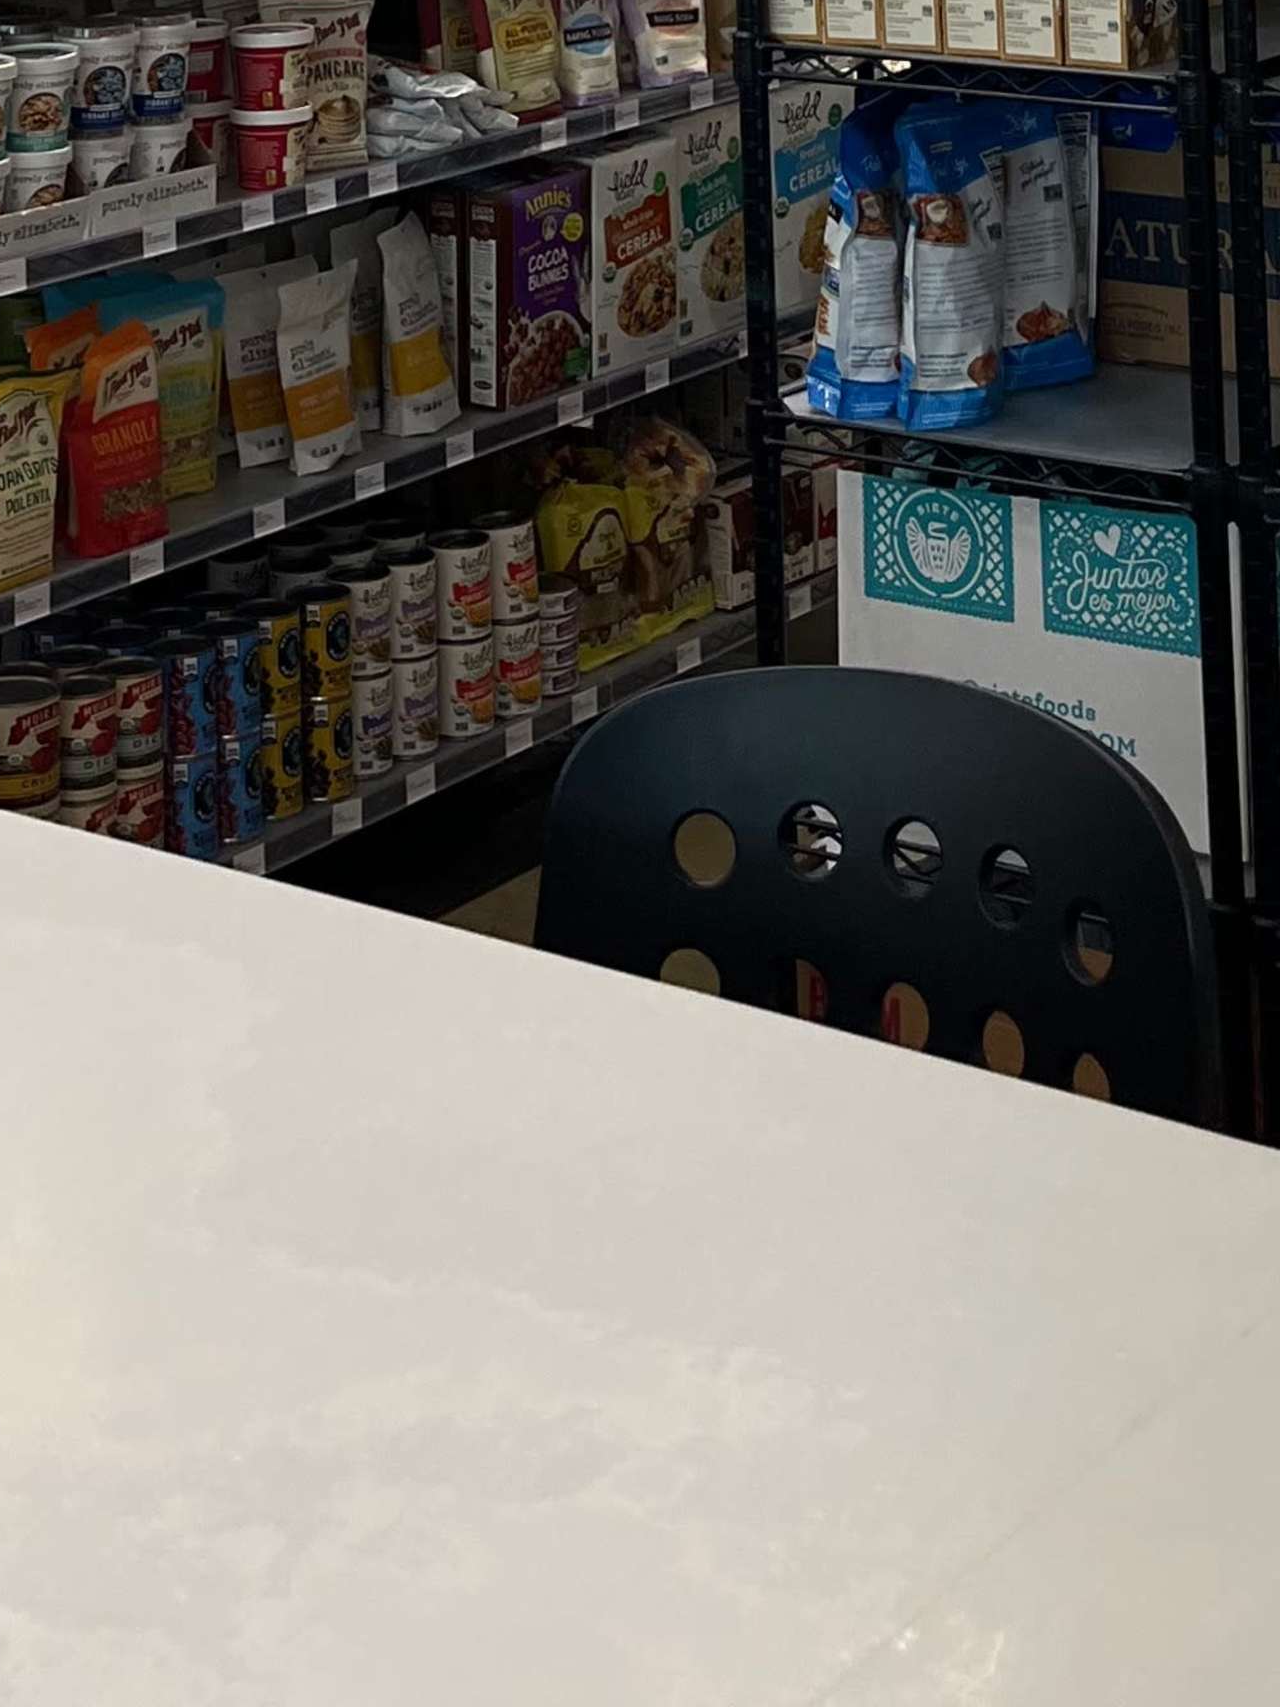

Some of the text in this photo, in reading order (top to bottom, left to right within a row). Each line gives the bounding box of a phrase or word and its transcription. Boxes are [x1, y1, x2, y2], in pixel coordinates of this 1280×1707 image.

[305, 60, 365, 80] PANCAKE
[789, 157, 841, 192] CEREAL
[101, 190, 145, 217] purely
[524, 185, 572, 222] Annie's
[694, 196, 741, 232] CEREAL
[616, 226, 664, 261] CEREAL
[527, 248, 569, 274] COCOA
[24, 457, 58, 477] GRITS
[5, 489, 51, 517] POLENTA
[916, 503, 961, 523] SIETE
[1066, 555, 1171, 610] Juntos
[1087, 591, 1183, 628] es mejor
[21, 705, 53, 728] MUIR
